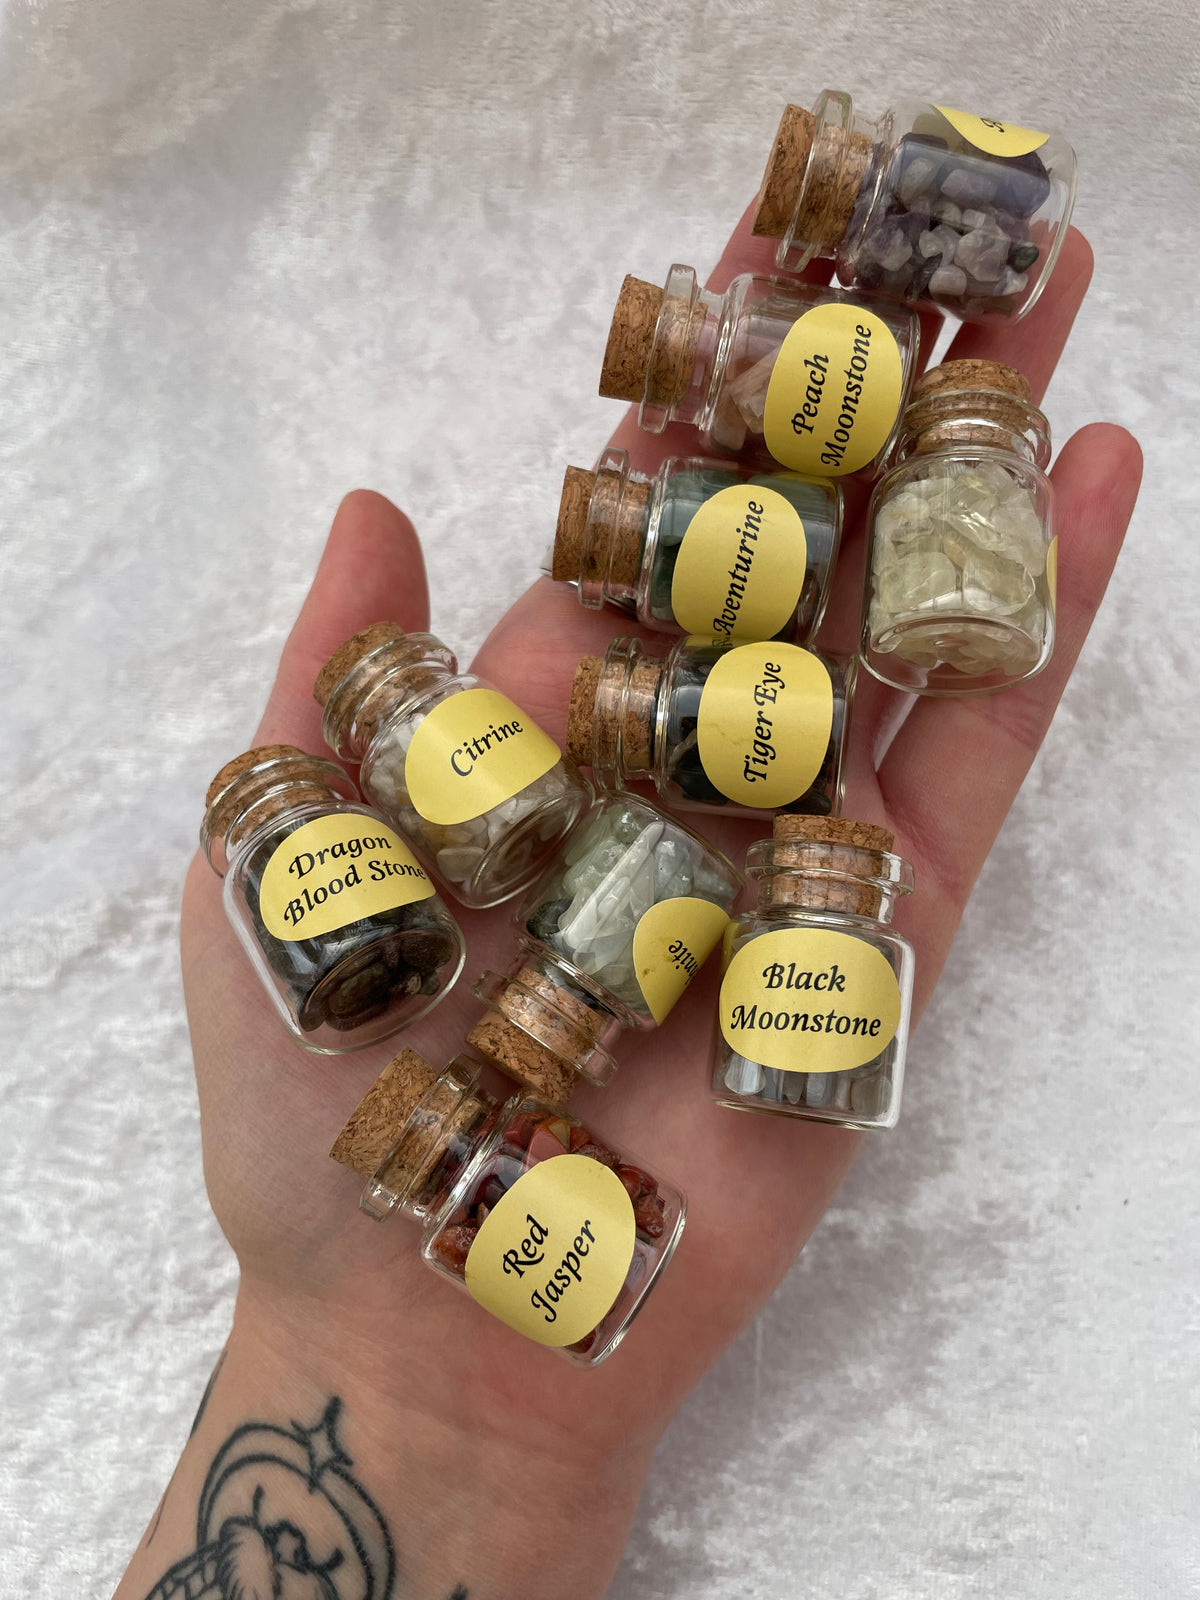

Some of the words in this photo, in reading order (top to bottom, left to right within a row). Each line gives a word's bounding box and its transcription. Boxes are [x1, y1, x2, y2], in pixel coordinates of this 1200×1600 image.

[791, 353, 829, 436] Peach
[820, 324, 872, 467] Moonstone
[712, 500, 765, 637] Aventurine
[754, 661, 785, 705] Eye
[450, 718, 524, 777] Citrine
[743, 712, 776, 783] Tiger
[288, 835, 392, 880] Dragon
[283, 867, 362, 928] Blood
[367, 860, 427, 882] Stone
[762, 962, 846, 992] Black
[730, 1004, 882, 1037] Moonstone
[502, 1213, 549, 1279] Red
[530, 1219, 595, 1323] Jasper
